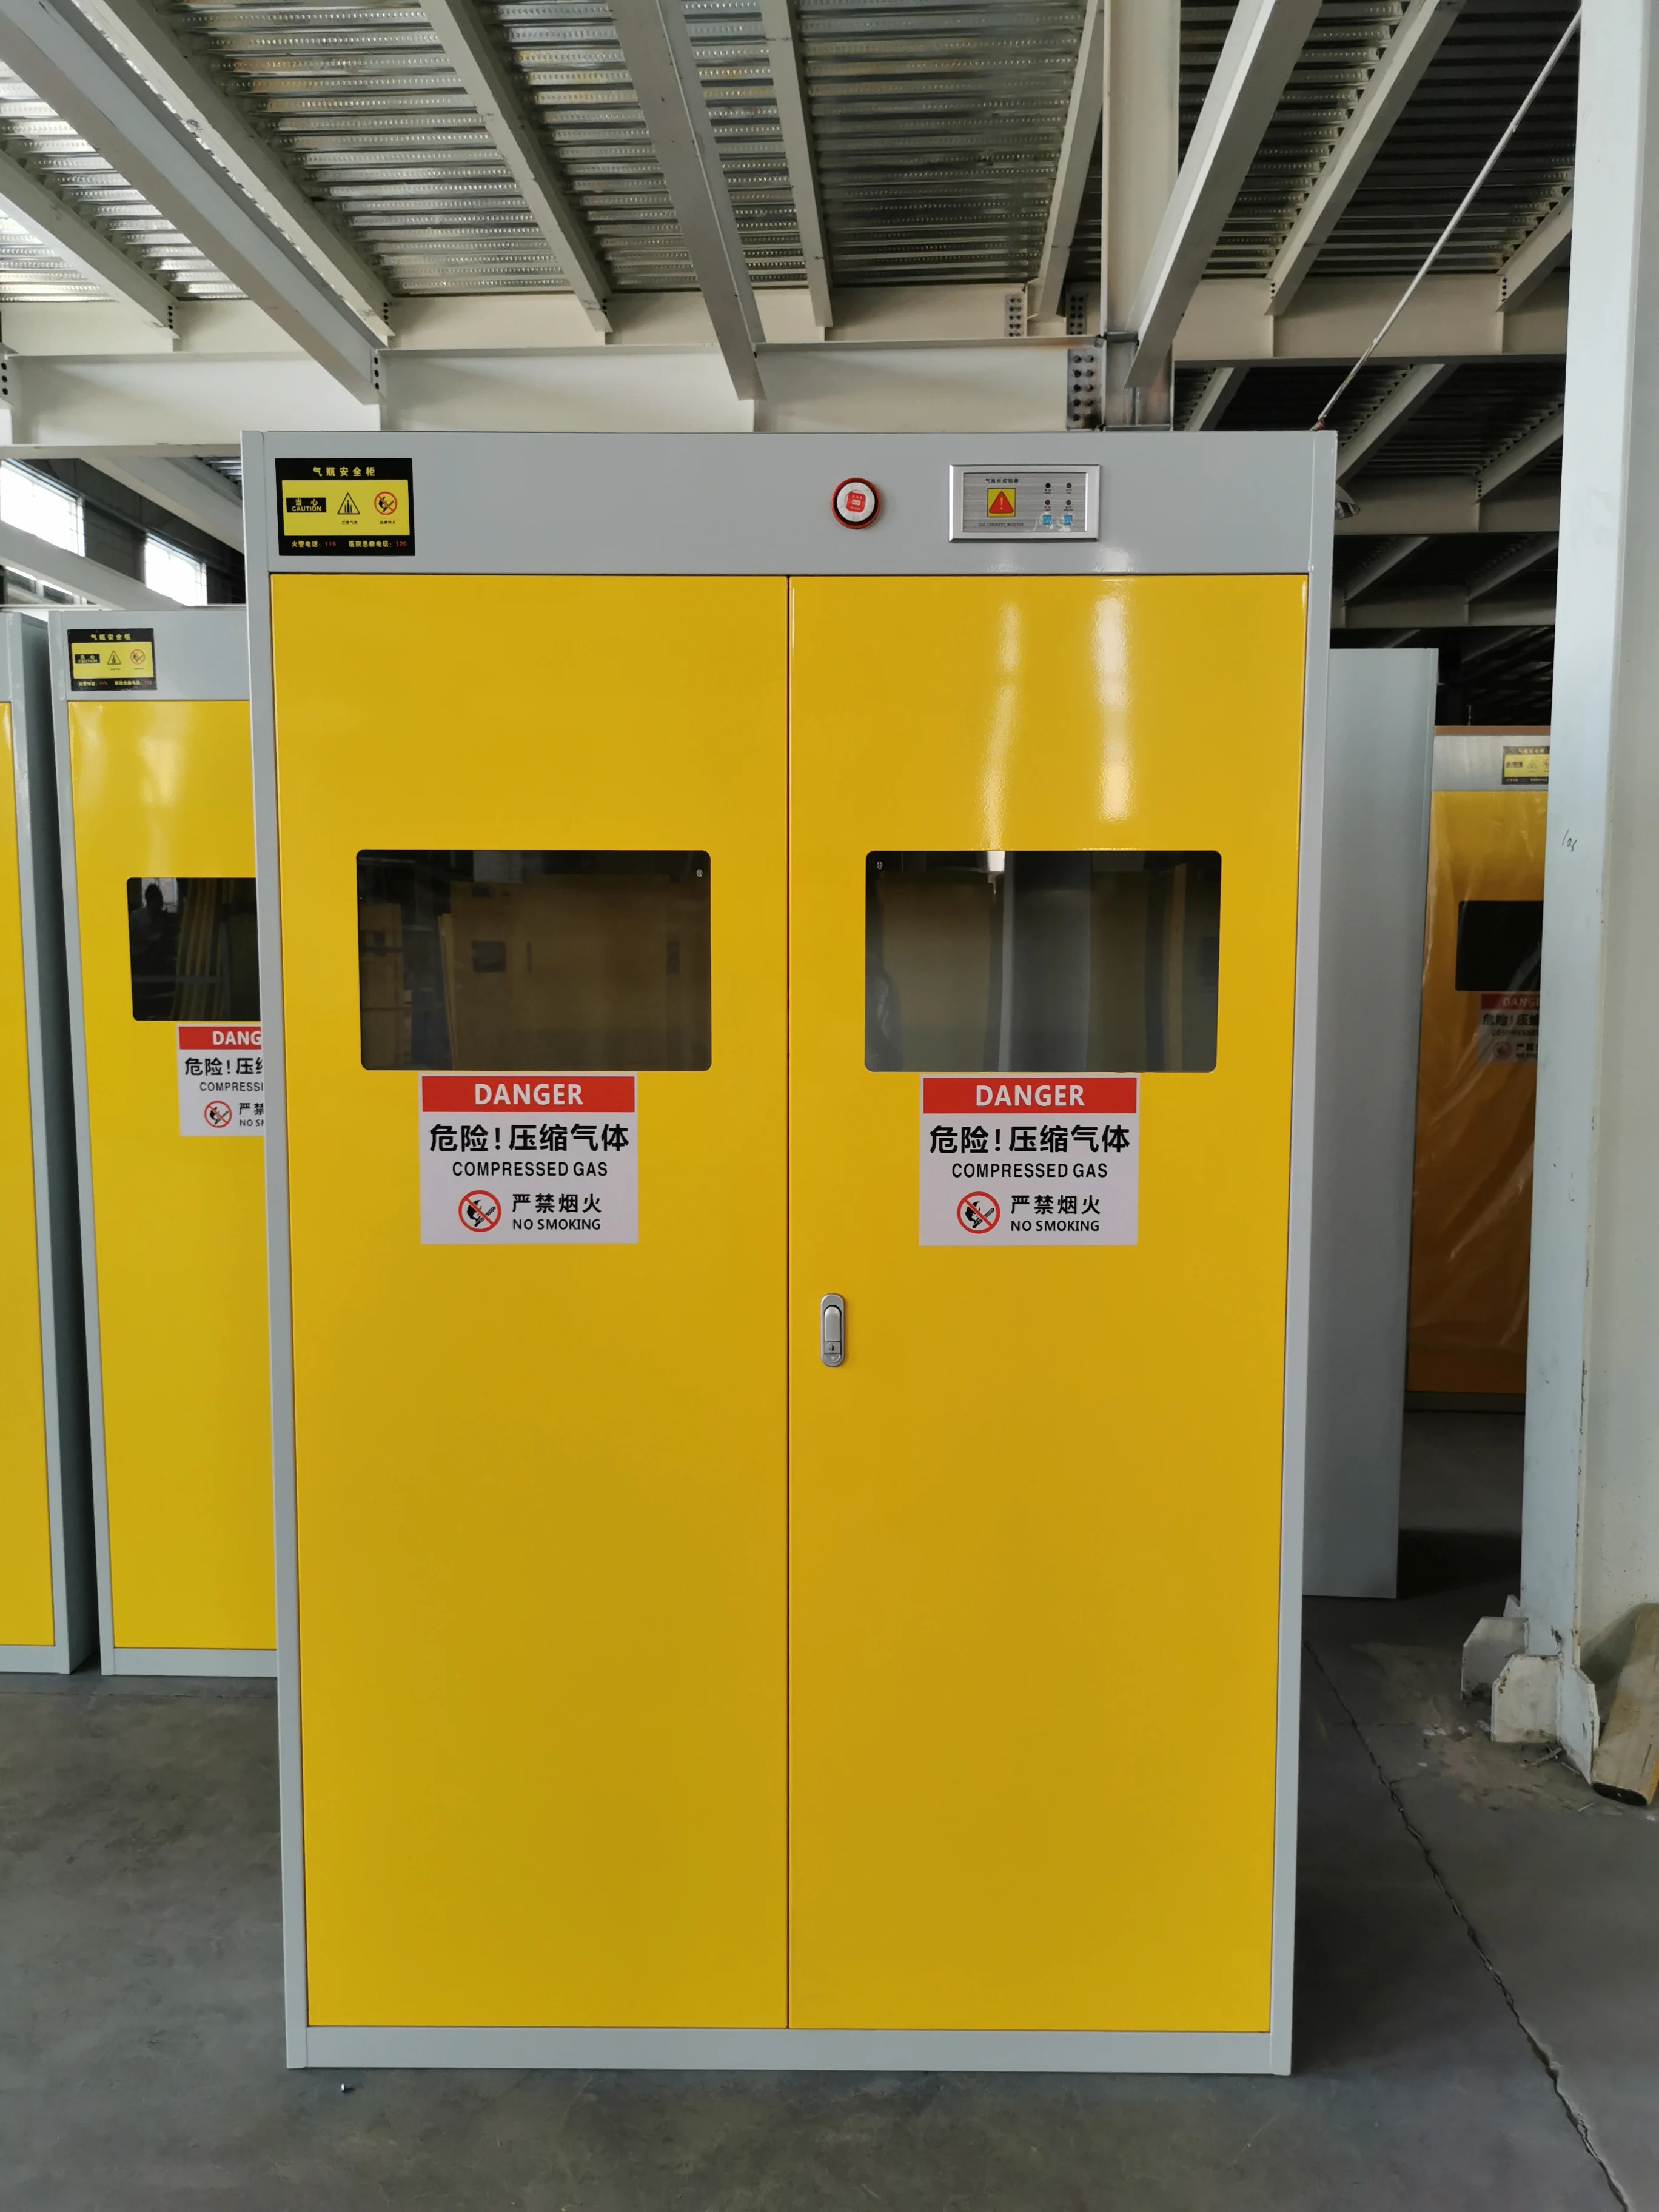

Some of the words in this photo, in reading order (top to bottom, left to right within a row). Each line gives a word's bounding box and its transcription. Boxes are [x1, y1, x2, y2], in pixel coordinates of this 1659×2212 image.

[313, 466, 375, 477] 气瓶安全柜
[199, 1082, 263, 1091] COMPRESS
[475, 1084, 583, 1105] DANGER
[976, 1085, 1085, 1107] DANGER
[429, 1124, 629, 1152] 危险!压缩气体
[930, 1125, 1130, 1153] 危险!压缩气体
[452, 1162, 568, 1176] COMPRESSED
[573, 1162, 608, 1176] GAS
[952, 1163, 1068, 1178] COMPRESSED
[1073, 1163, 1108, 1178] GAS
[512, 1193, 602, 1213] 严禁烟火
[1010, 1195, 1101, 1215] 严禁烟火
[512, 1219, 533, 1230] NO
[537, 1219, 601, 1230] SMOKING
[1011, 1220, 1031, 1232] NO
[1036, 1220, 1100, 1232] SMOKING
